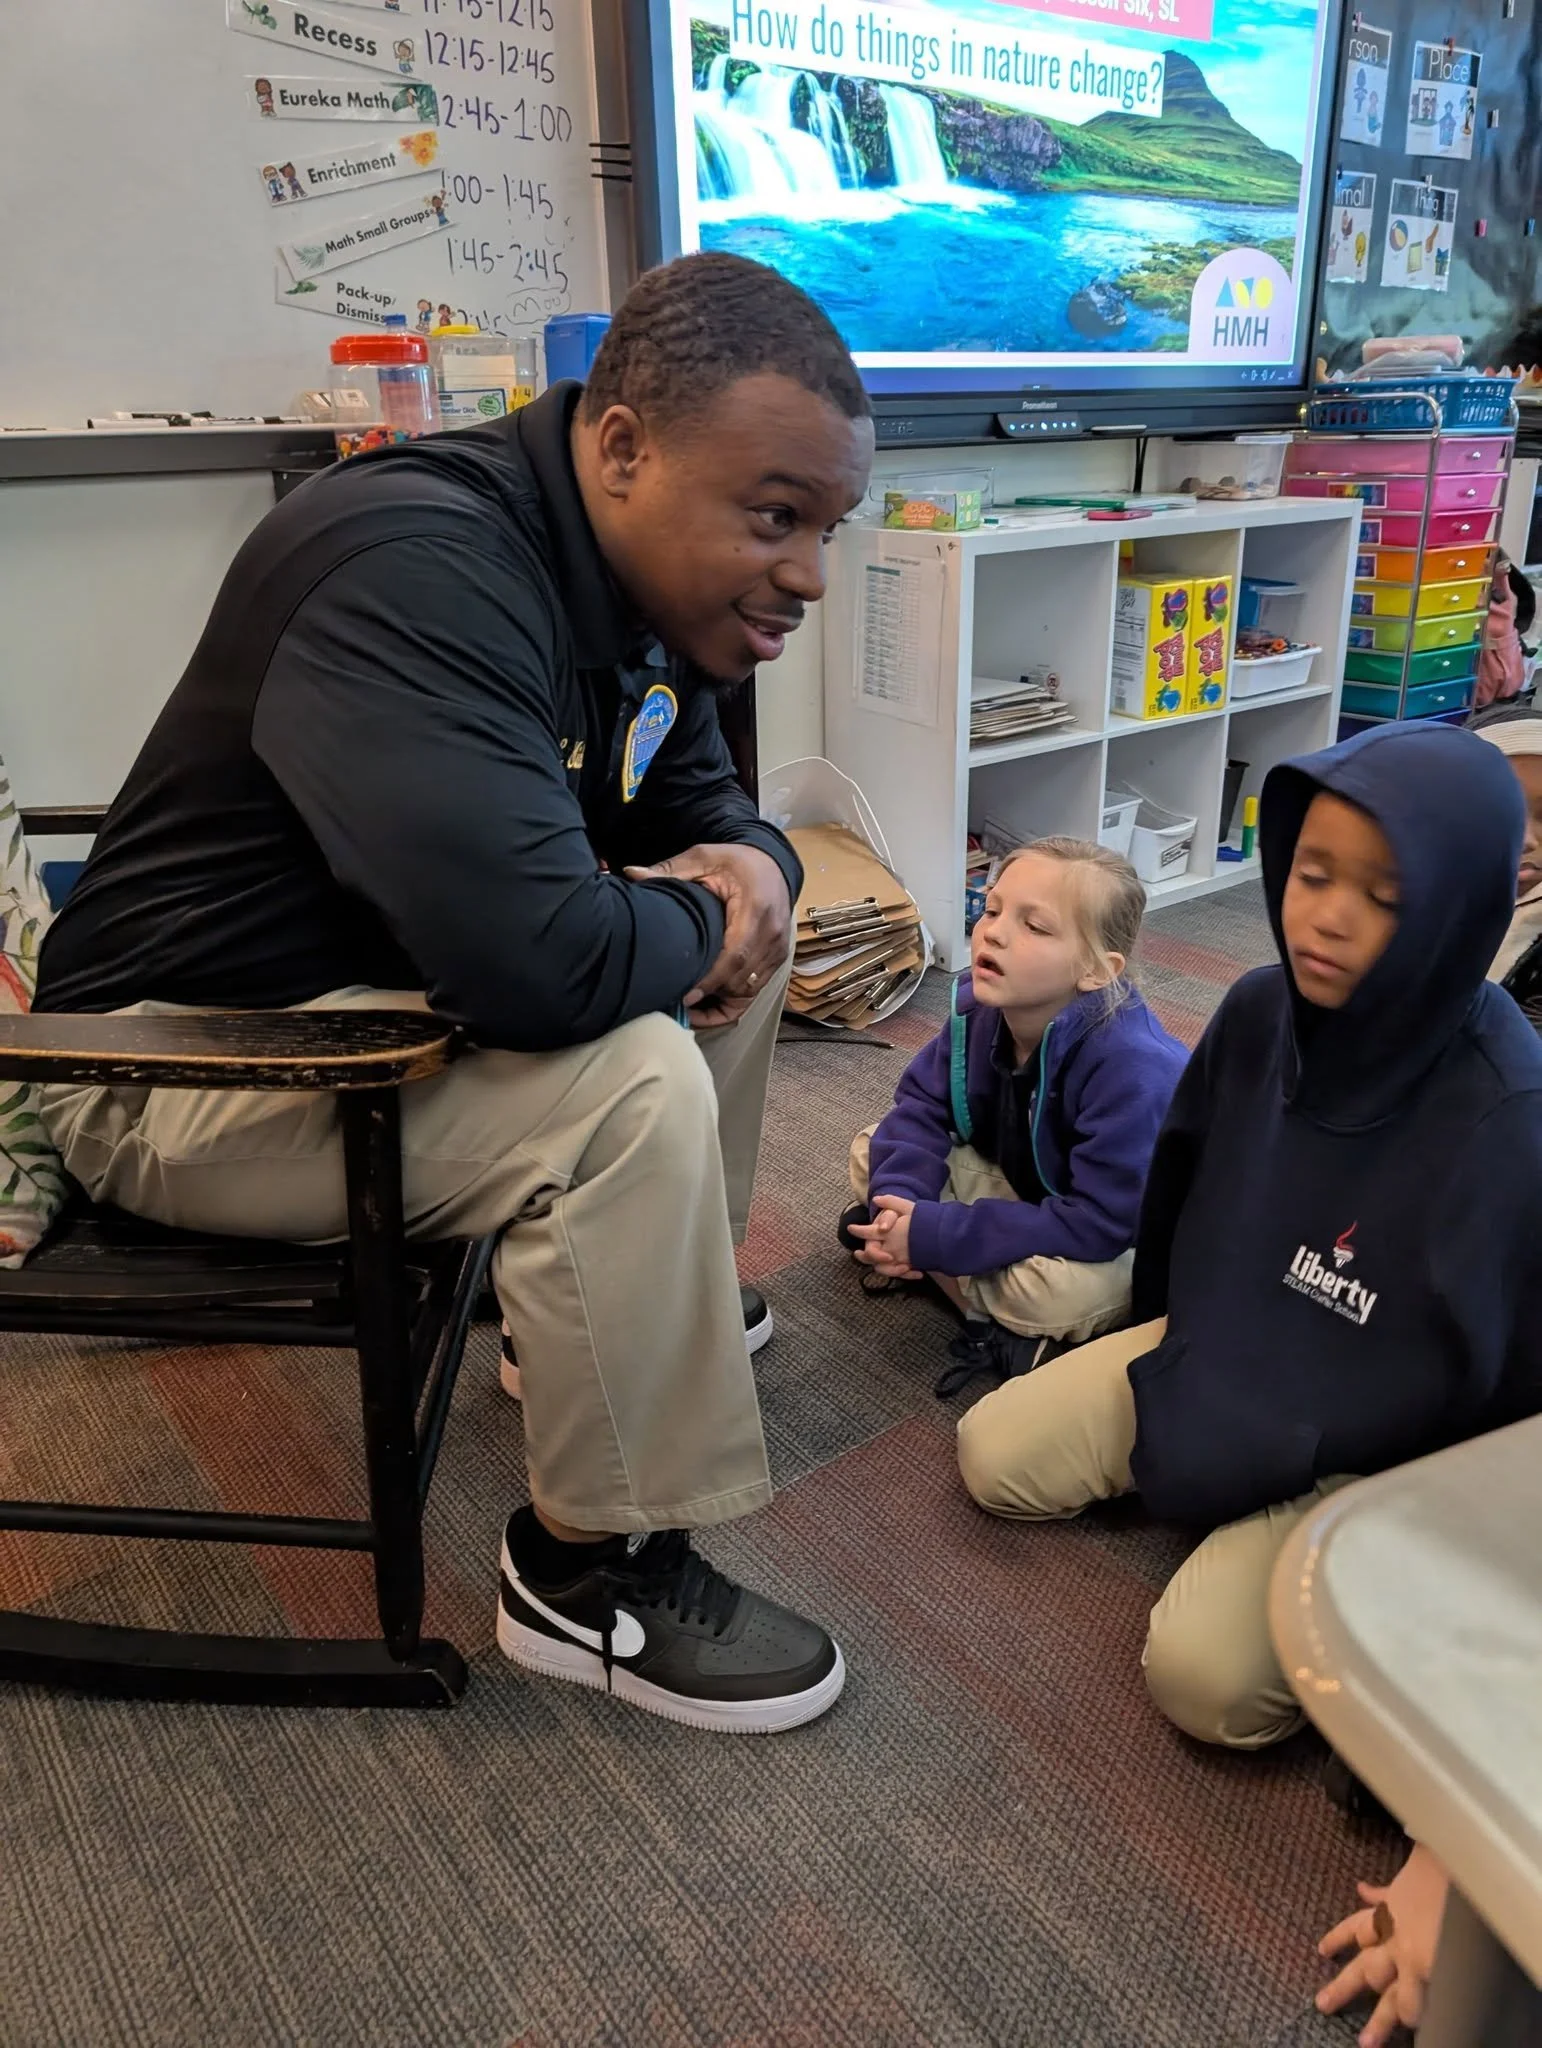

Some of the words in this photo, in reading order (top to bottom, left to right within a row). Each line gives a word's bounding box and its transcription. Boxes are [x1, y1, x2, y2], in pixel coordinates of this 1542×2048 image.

[1158, 0, 1180, 23] SL
[294, 12, 378, 57] Recess
[732, 0, 798, 51] How
[811, 4, 844, 58] do
[855, 12, 940, 80] things
[951, 28, 973, 77] in
[983, 41, 1060, 90] nature
[1070, 49, 1163, 110] change?
[1349, 38, 1379, 63] rson
[1428, 48, 1470, 82] Place
[279, 89, 341, 107] Eureka
[347, 91, 391, 109] Math
[307, 153, 397, 184] Enrichment
[325, 234, 356, 254] Math
[356, 221, 389, 242] Small
[389, 208, 431, 231] Groups
[336, 282, 397, 307] Pack-up/
[336, 302, 386, 323] Dismiss
[1213, 316, 1270, 347] HMH
[1282, 1273, 1312, 1295] STEAM
[1289, 1244, 1378, 1325] liberty
